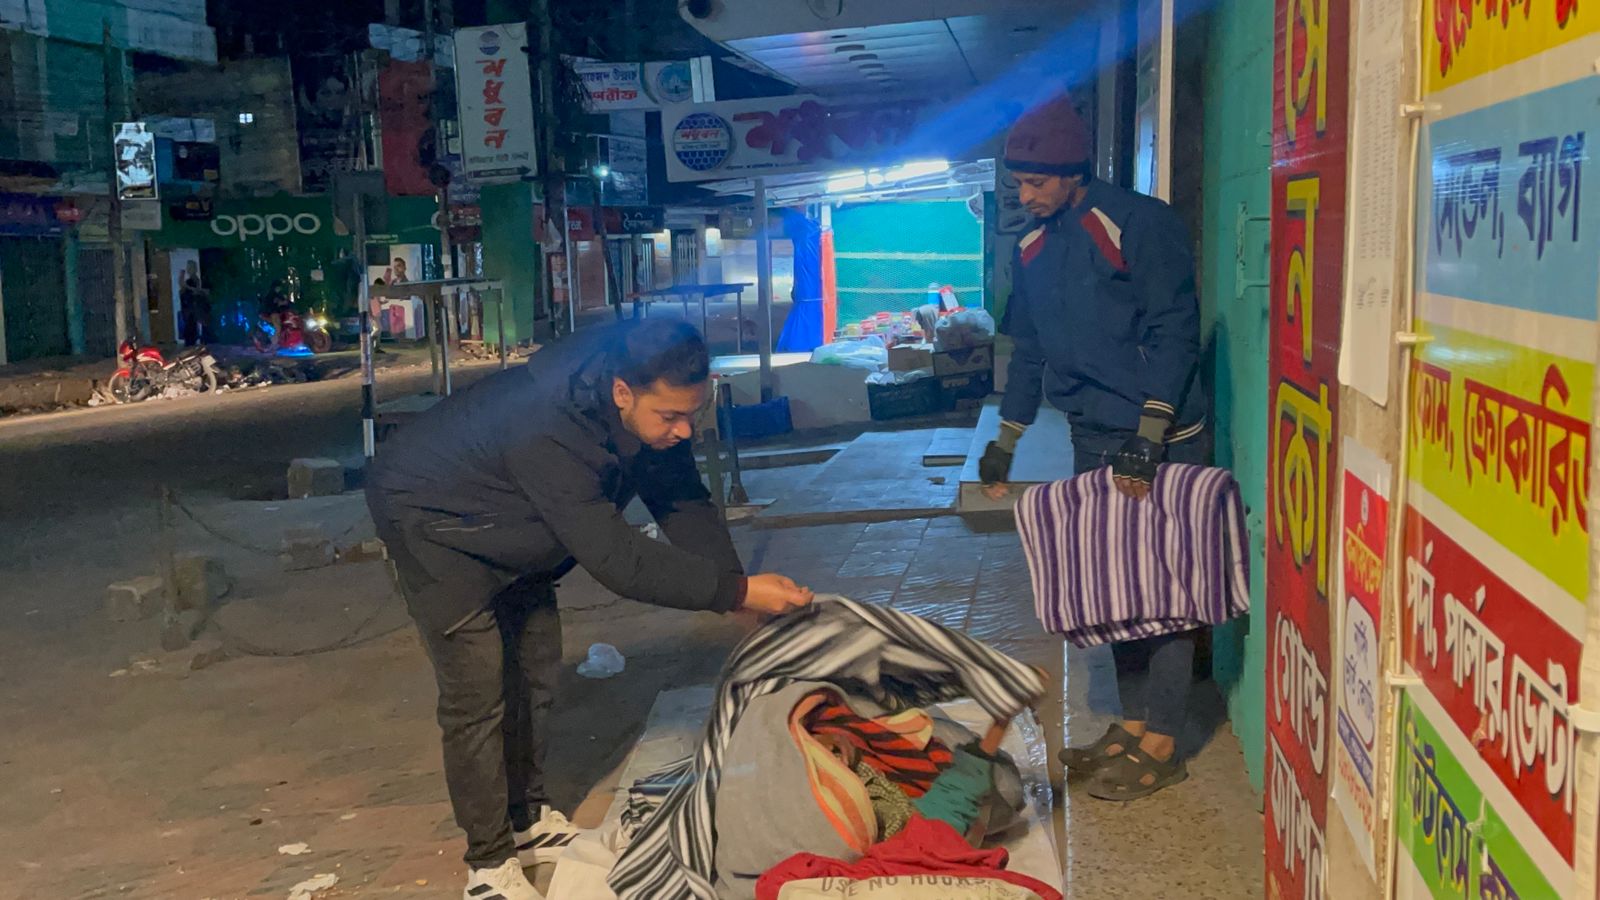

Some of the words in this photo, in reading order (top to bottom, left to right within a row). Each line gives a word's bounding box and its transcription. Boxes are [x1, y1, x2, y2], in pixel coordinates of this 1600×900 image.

[476, 58, 507, 149] মধুবন
[211, 213, 321, 241] oppo
[1517, 131, 1585, 261] ব্যাগ
[1273, 610, 1327, 776] গোল্ড
